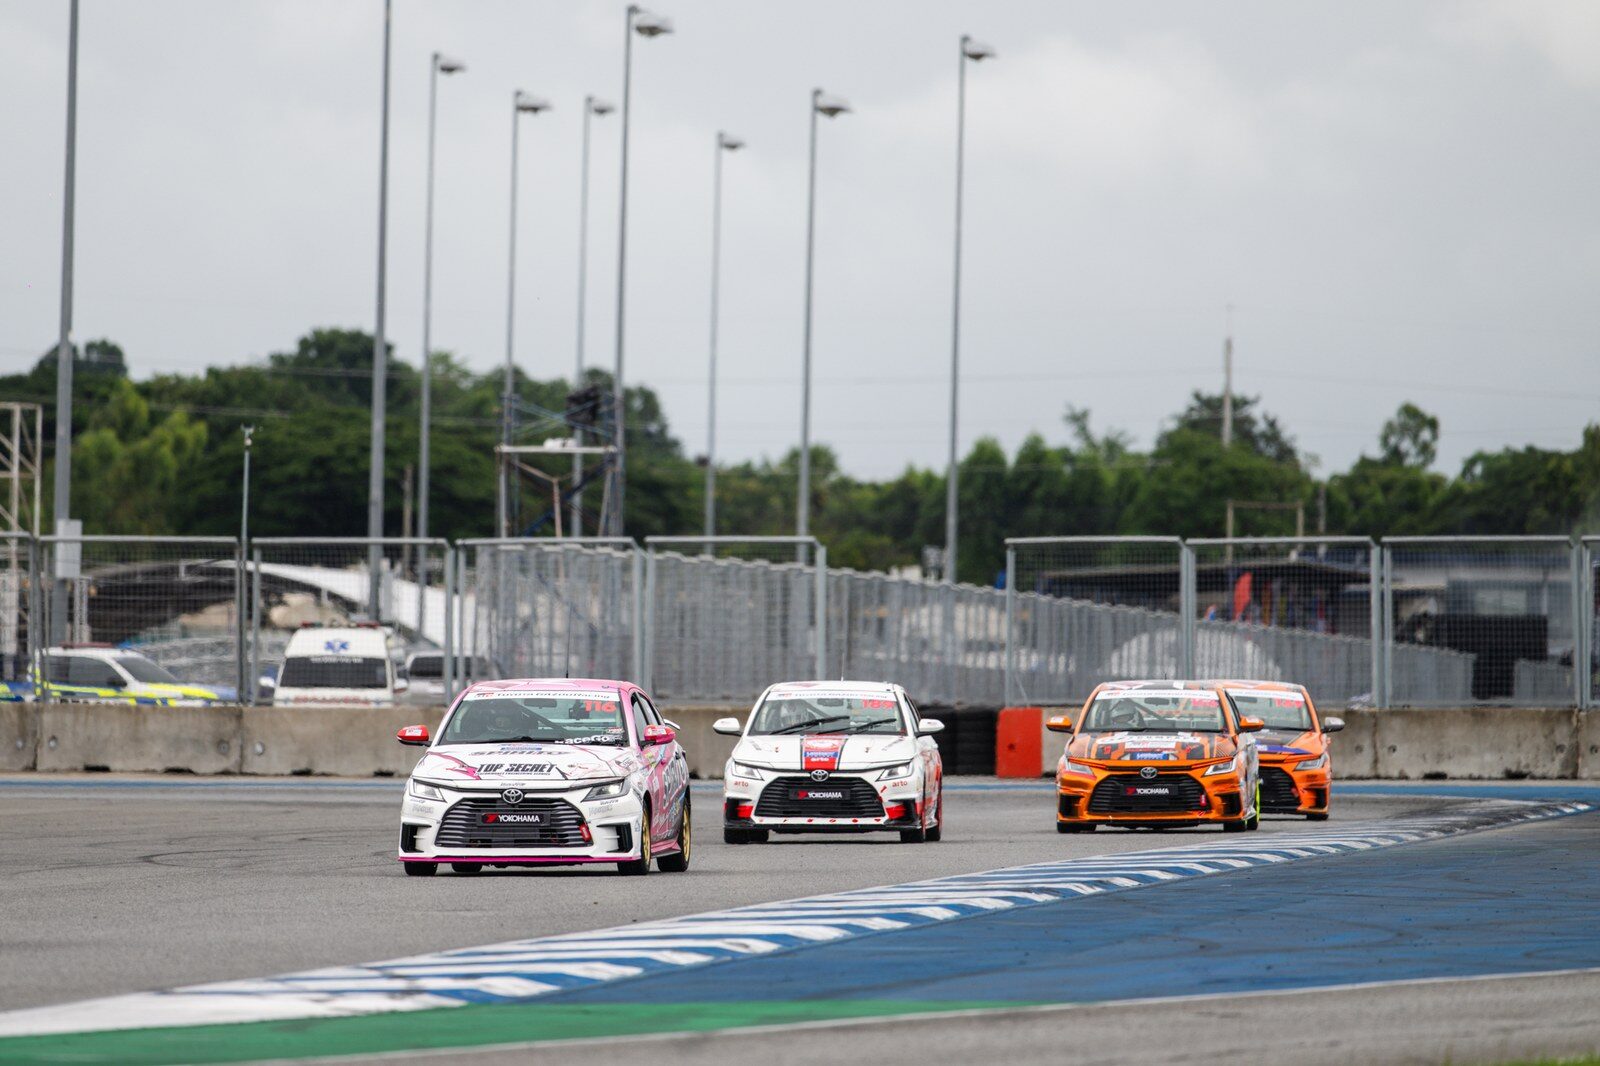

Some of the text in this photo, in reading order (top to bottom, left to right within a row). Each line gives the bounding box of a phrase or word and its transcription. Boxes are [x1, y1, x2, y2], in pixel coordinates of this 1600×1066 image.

[583, 699, 616, 713] 116
[477, 763, 557, 773] TOP SECRET
[892, 780, 908, 788] arto
[498, 815, 540, 823] YOKOHAMA
